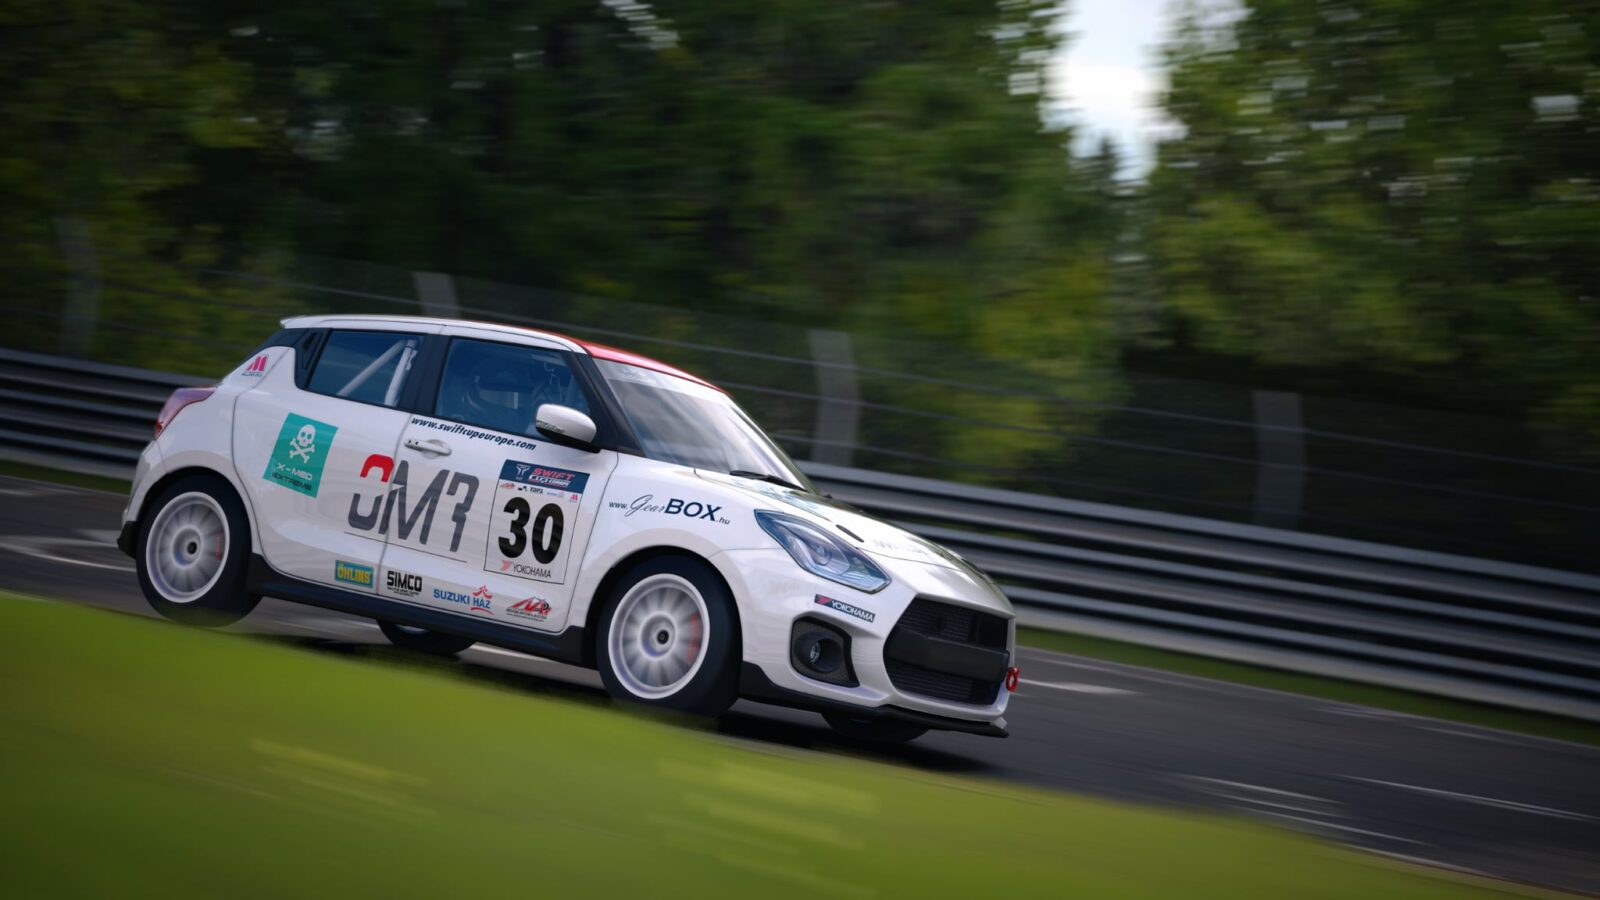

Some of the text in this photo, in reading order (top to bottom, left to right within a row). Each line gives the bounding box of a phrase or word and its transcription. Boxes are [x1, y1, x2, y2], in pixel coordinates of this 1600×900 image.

[411, 418, 537, 450] www.swiftcupeurope.com
[531, 467, 576, 480] SWIFT
[498, 496, 564, 565] 30
[337, 563, 370, 584] ÖHLINS
[513, 563, 552, 578] YOKOHAMA
[386, 570, 423, 593] SIMCO
[433, 588, 471, 605] SUZUKI
[831, 600, 874, 621] YOKOHAMA
